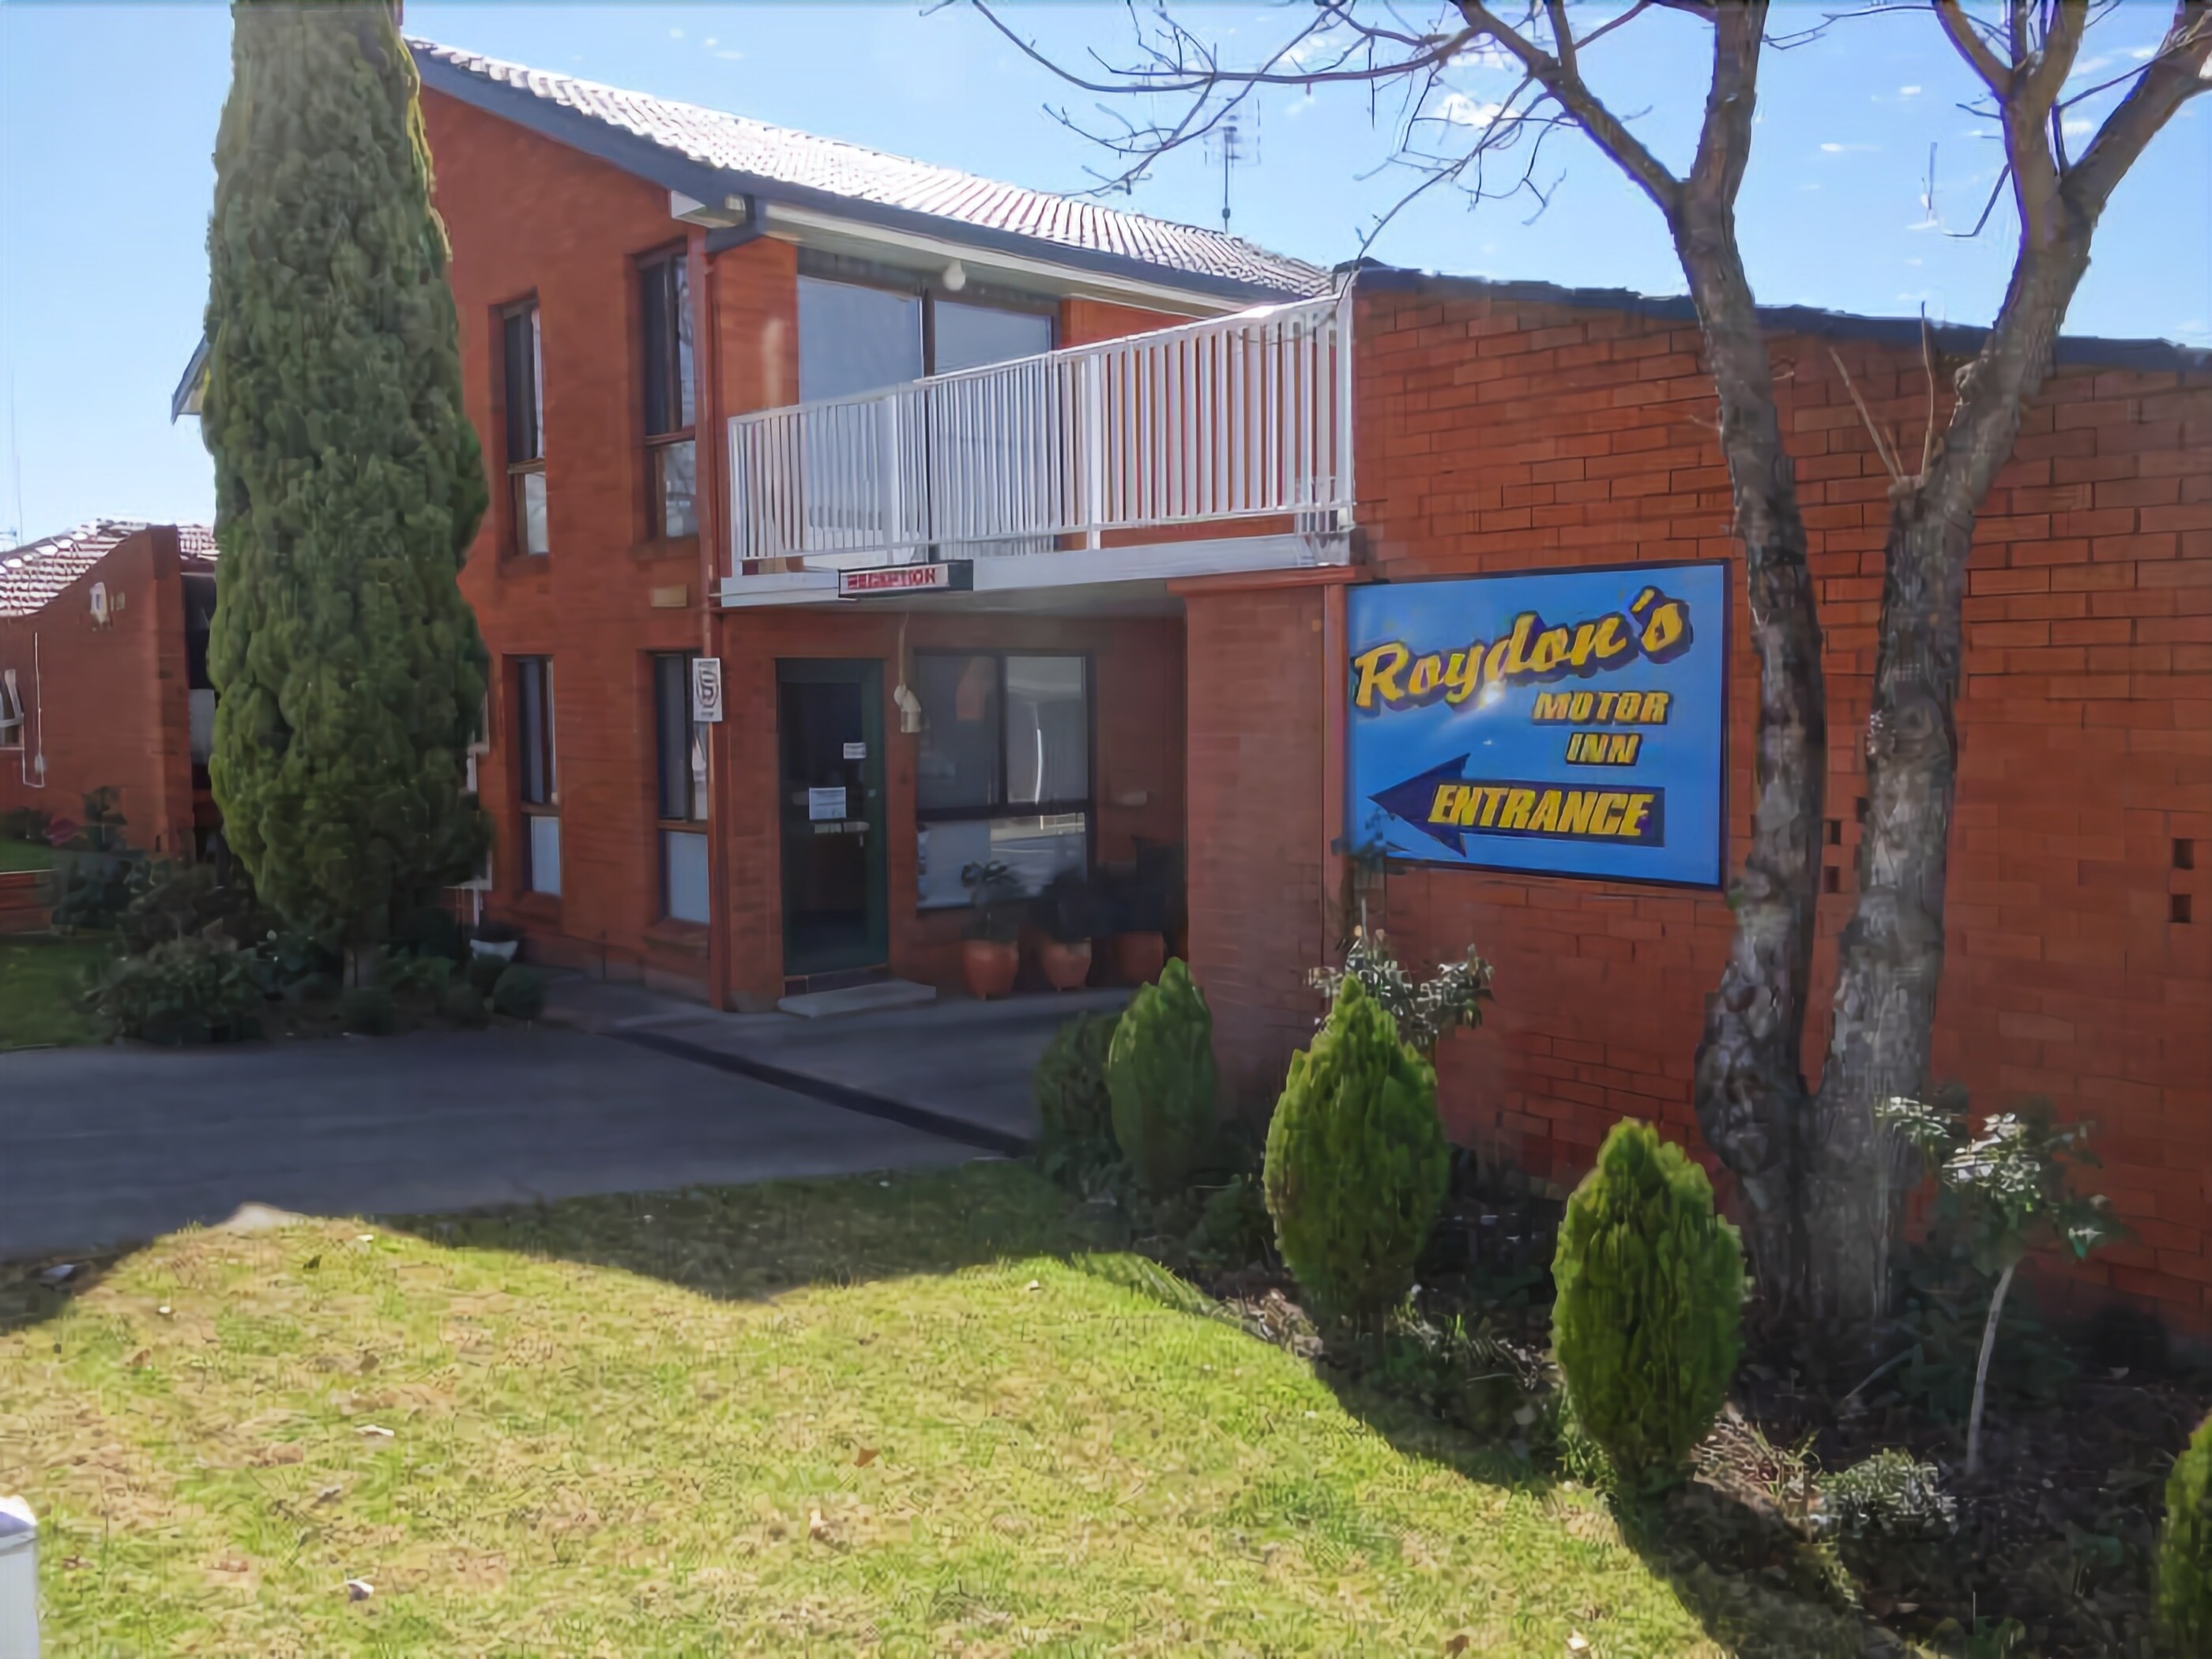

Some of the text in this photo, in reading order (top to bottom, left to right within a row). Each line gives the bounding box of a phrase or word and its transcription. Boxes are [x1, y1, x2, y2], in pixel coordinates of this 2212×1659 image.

[1353, 587, 1684, 708] Roydon's
[1531, 690, 1671, 723] MOTOR
[1566, 732, 1642, 764] INN
[1427, 784, 1655, 837] ENTRANCE
